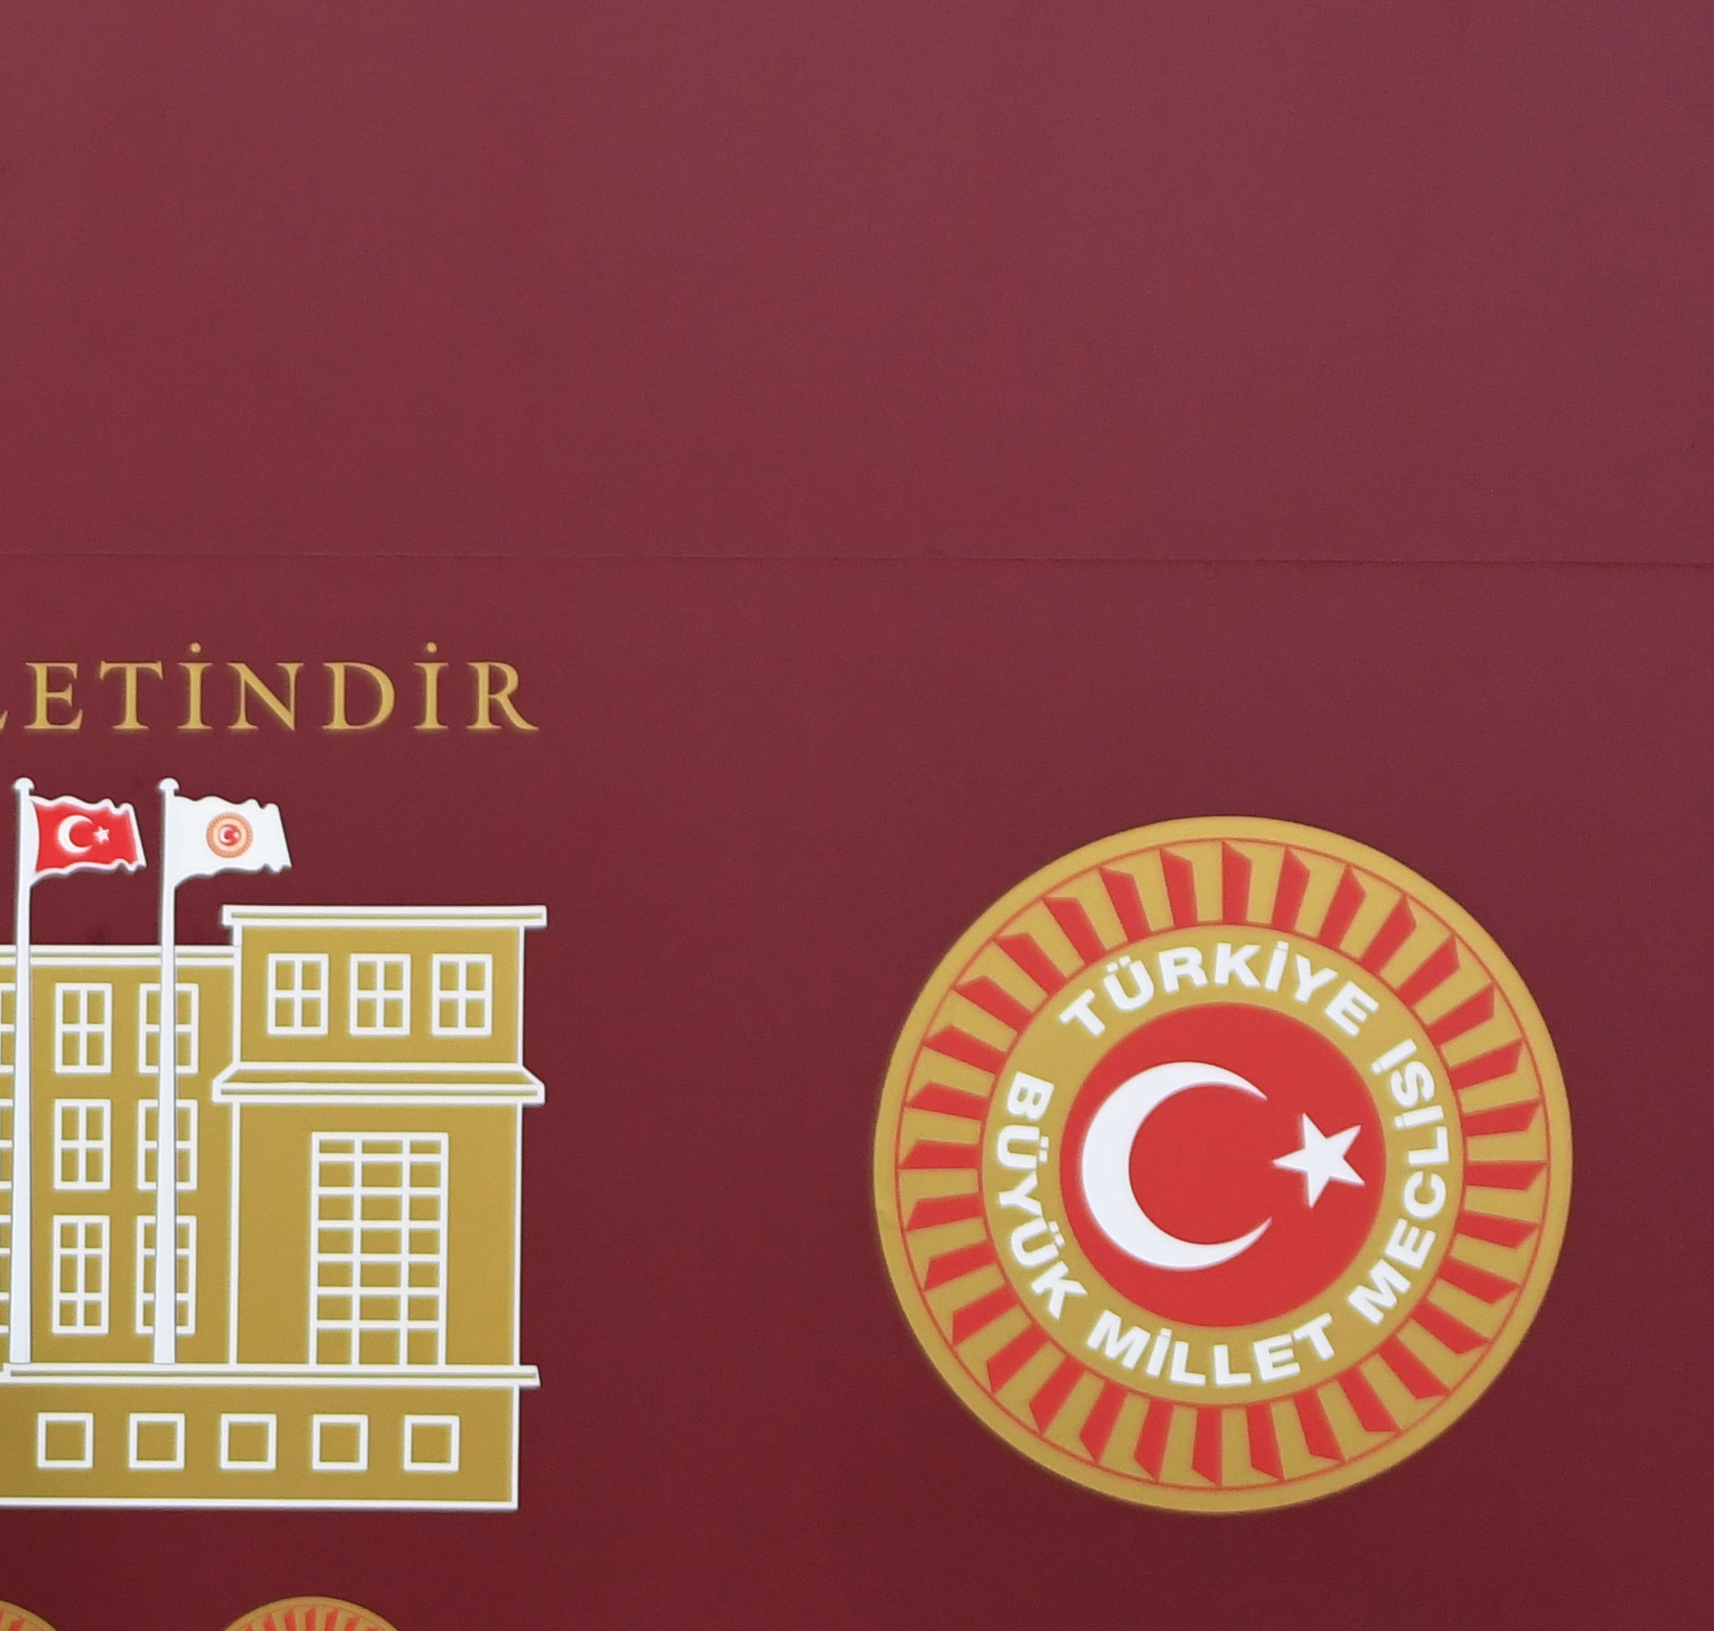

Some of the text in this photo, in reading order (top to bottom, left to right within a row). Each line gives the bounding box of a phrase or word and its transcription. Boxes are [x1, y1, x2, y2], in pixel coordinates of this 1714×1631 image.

[1057, 941, 1380, 1038] TÜRKİYE
[994, 1039, 1450, 1389] BÜYÜK MİLLET MECLİSİ
